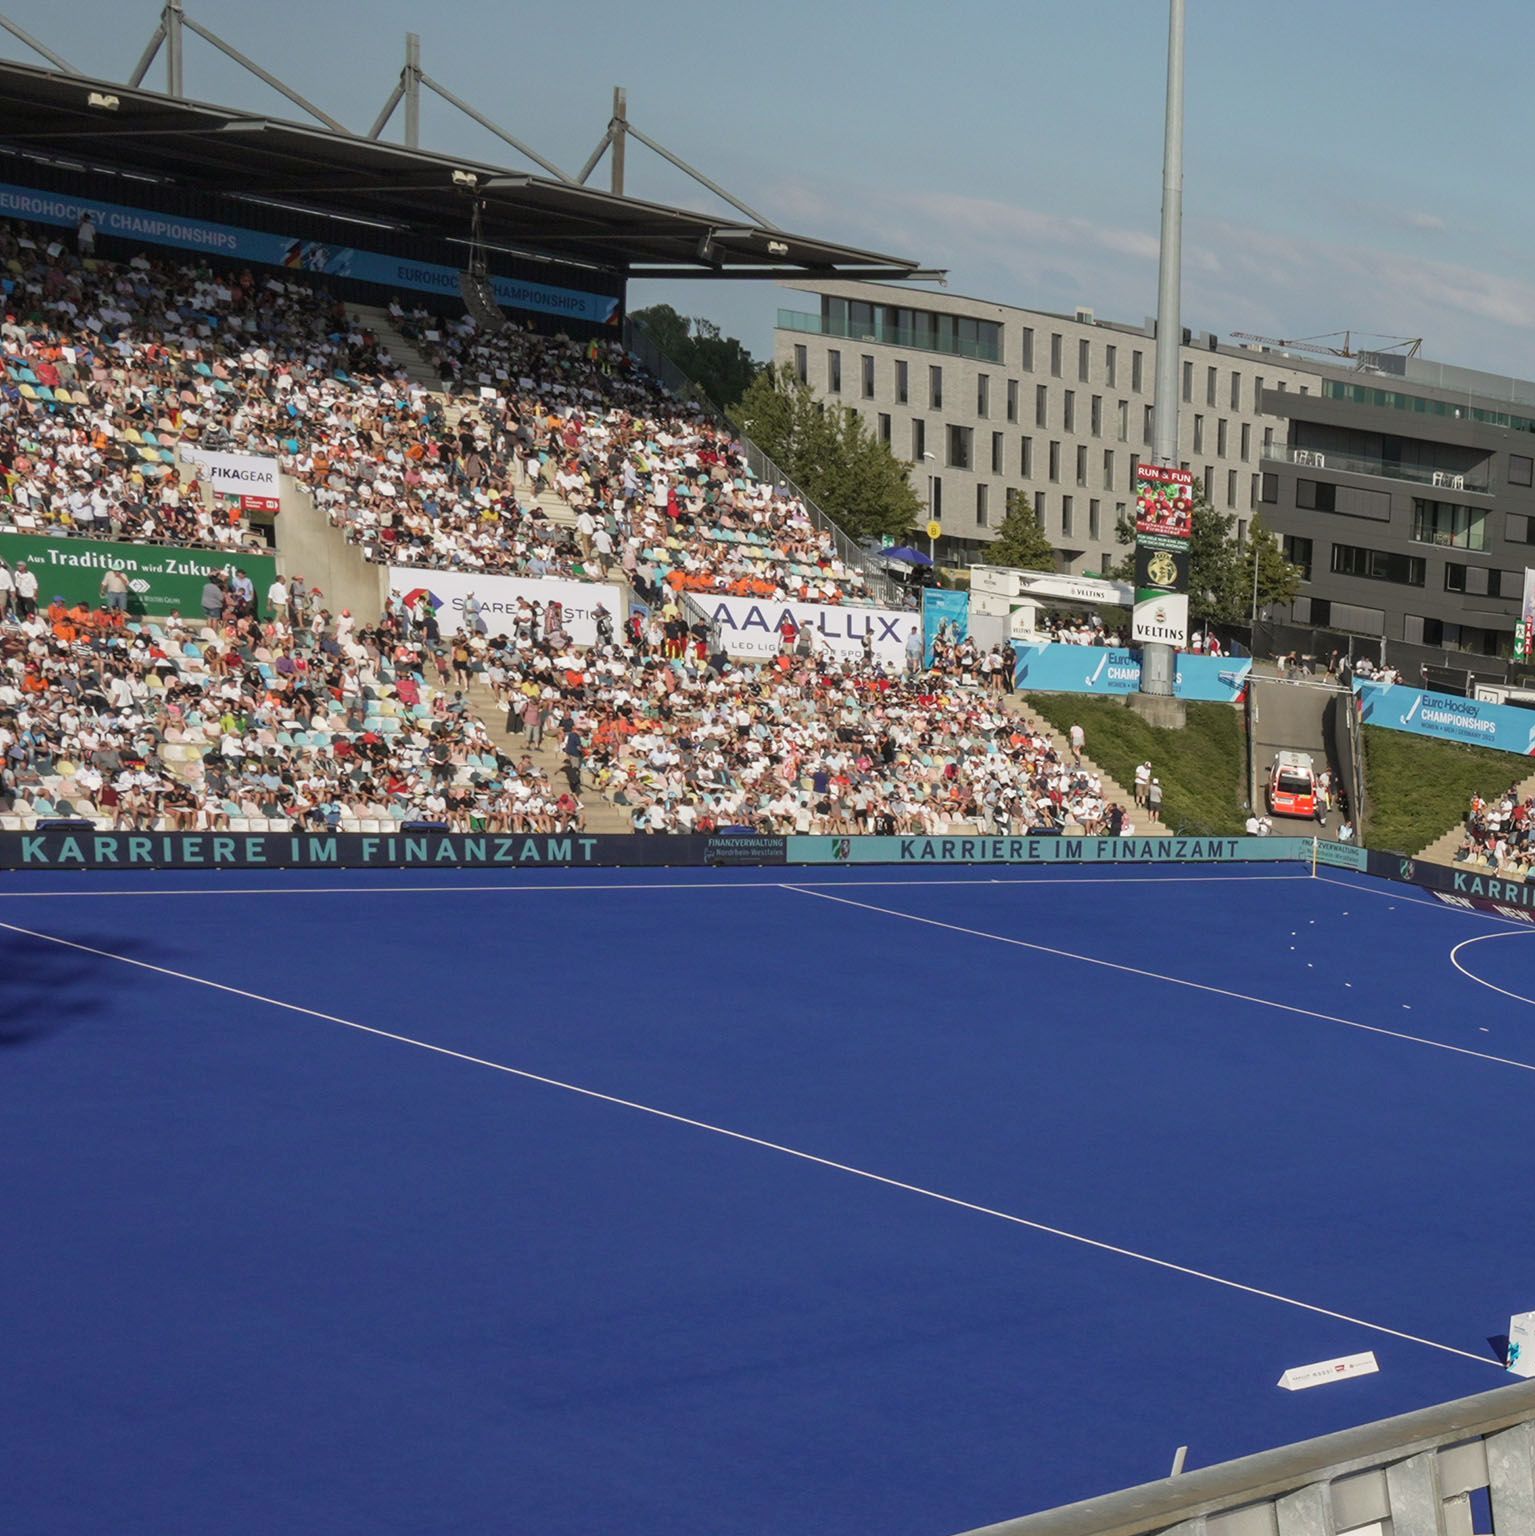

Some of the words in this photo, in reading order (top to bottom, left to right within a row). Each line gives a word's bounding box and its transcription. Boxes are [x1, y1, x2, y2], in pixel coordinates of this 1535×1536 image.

[110, 213, 237, 249] CHAMPIONSHIPS
[489, 282, 586, 312] HAMPIONSHIPS
[211, 466, 273, 483] FIKAGEAR
[1138, 467, 1159, 478] RUN
[1171, 472, 1191, 483] FUN
[27, 554, 46, 564] Aus
[48, 549, 138, 571] Tradition
[141, 563, 163, 574] wird
[165, 558, 238, 578] Zukuft
[1076, 588, 1105, 599] VELTINS
[452, 597, 517, 616] SARE
[712, 602, 902, 643] AAA-LUX
[1137, 624, 1184, 640] VELTINS
[732, 641, 754, 651] LED
[1421, 708, 1496, 733] CHAMPIONSHIPS
[21, 836, 267, 863] KARRIERE
[292, 837, 337, 862] IM
[362, 837, 598, 862] FINANZAMT
[708, 838, 783, 848] FINANZVERWALTUNG
[901, 839, 1041, 859] KARRIERE
[1056, 839, 1083, 859] IM
[1097, 839, 1239, 859] FINANZAMT
[1433, 891, 1476, 910] NEW
[1492, 903, 1534, 923] NEW
